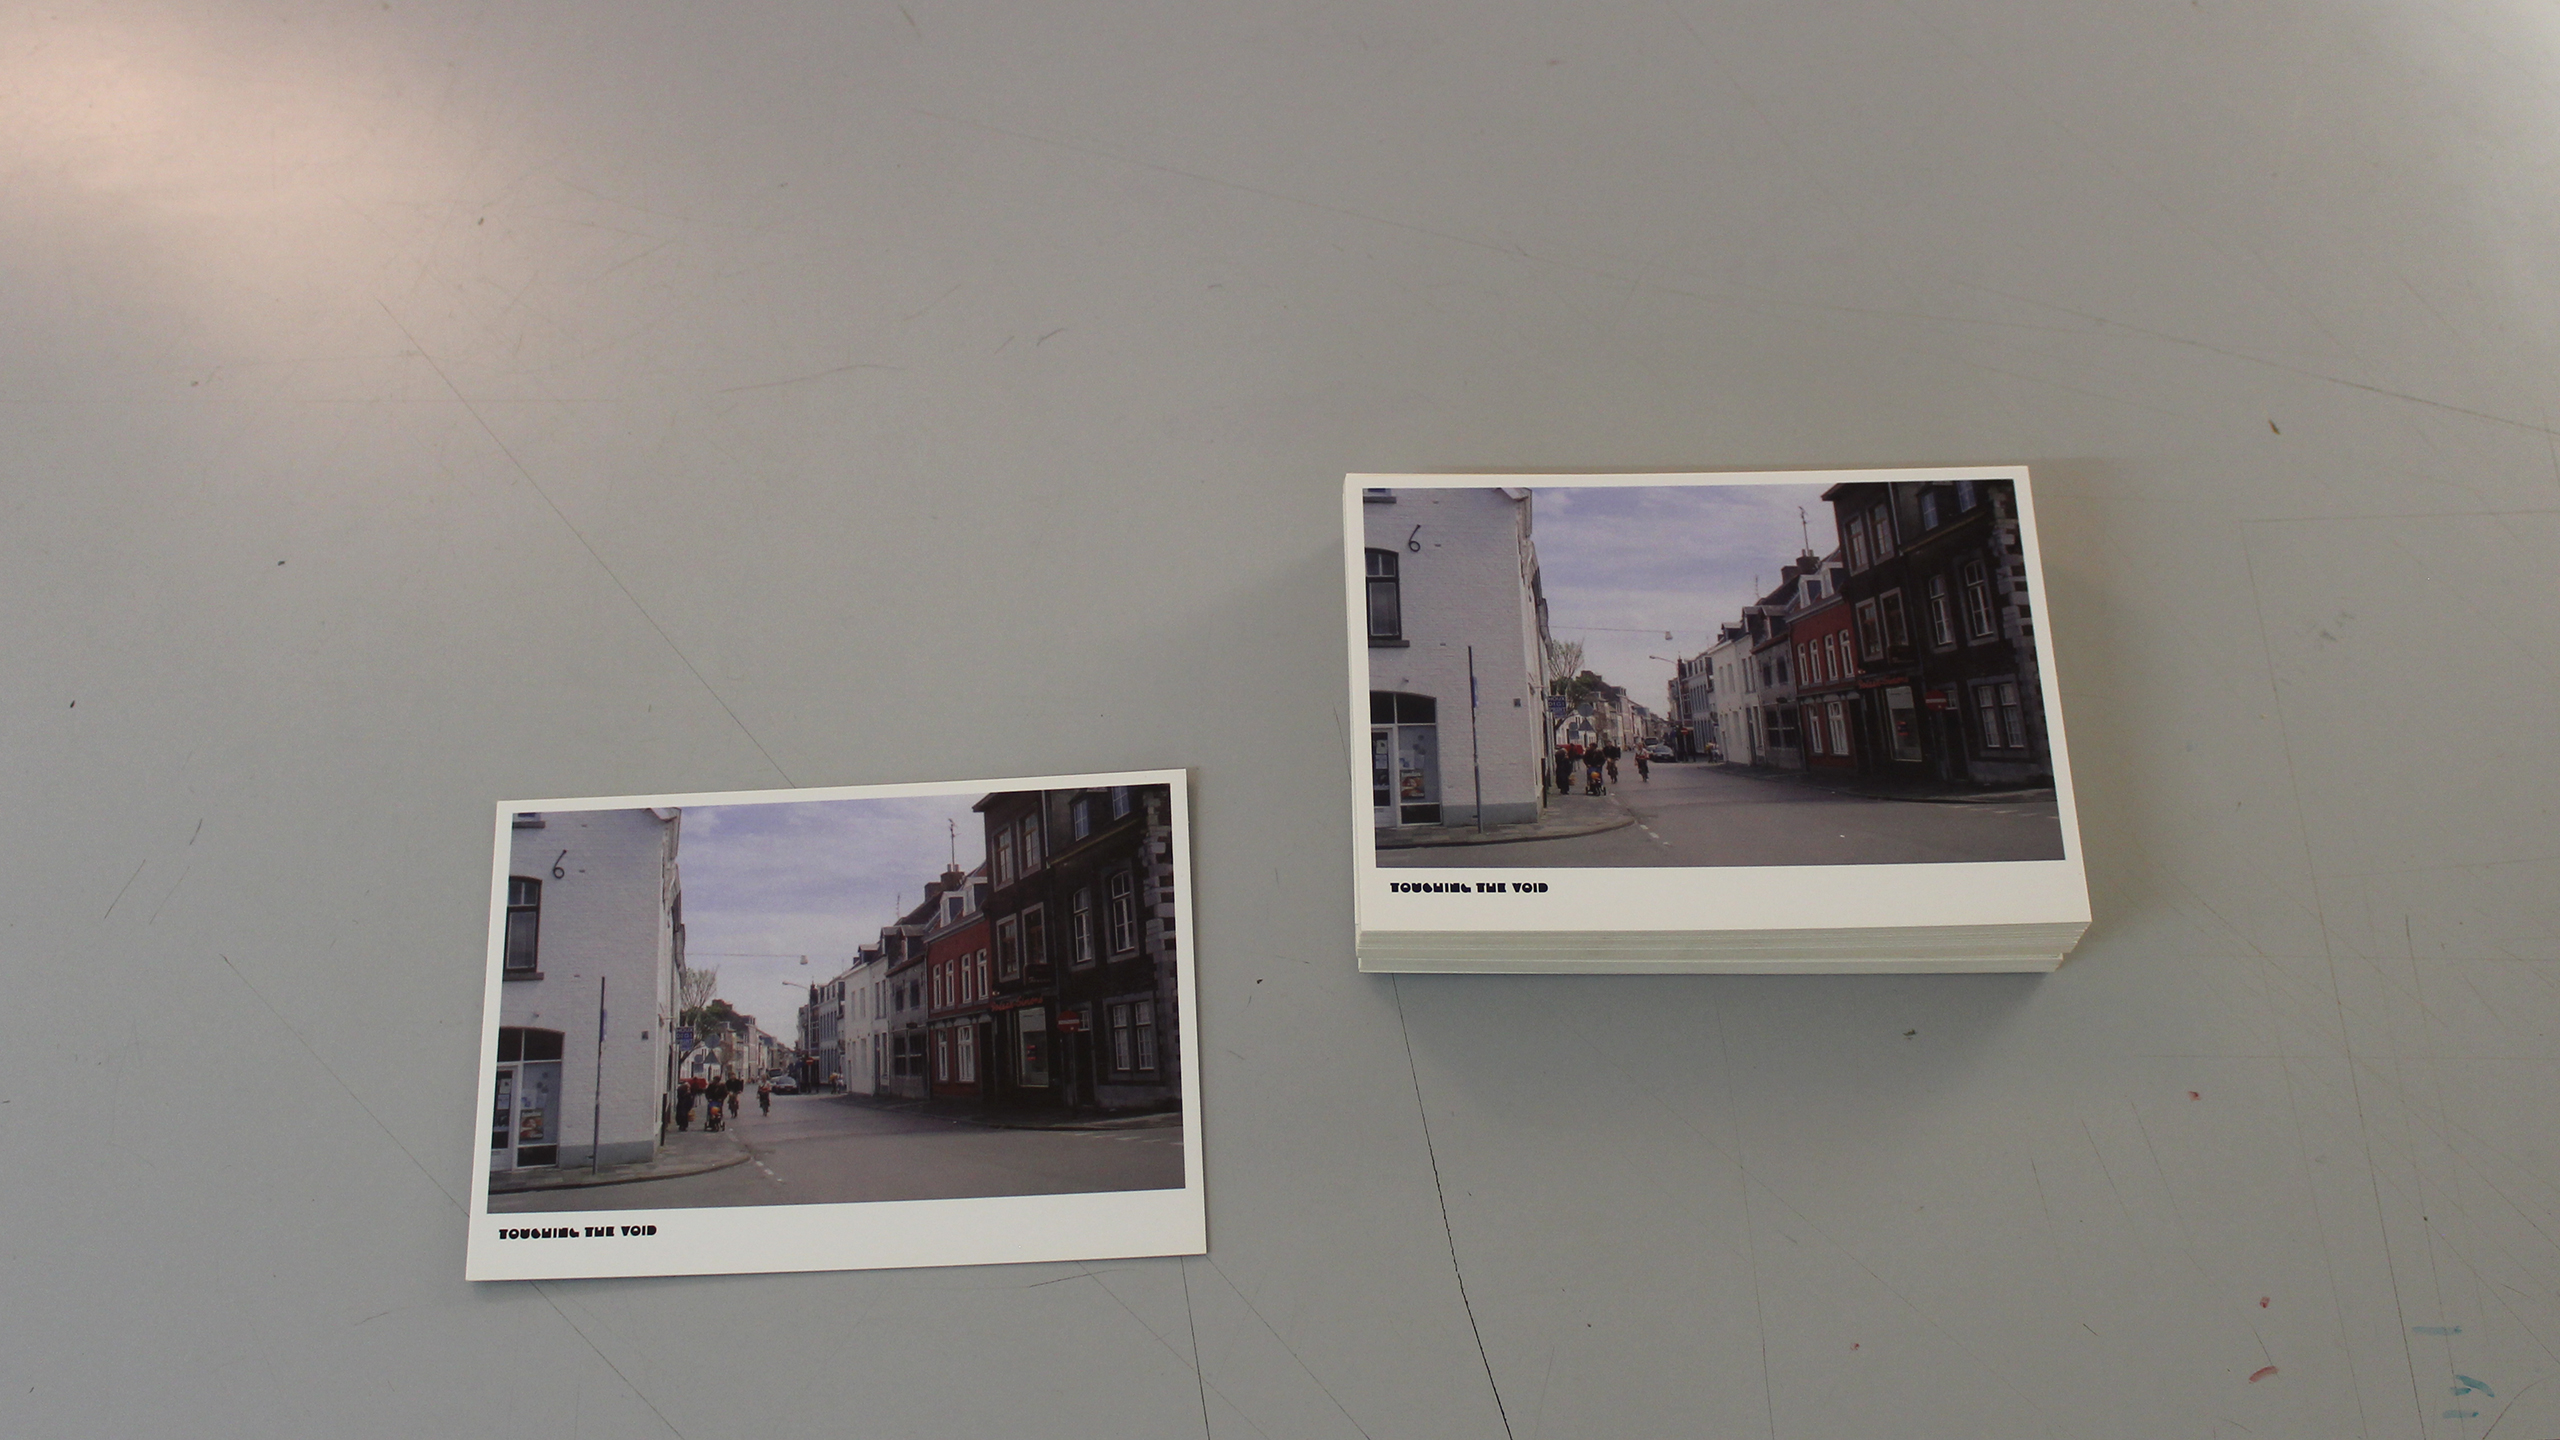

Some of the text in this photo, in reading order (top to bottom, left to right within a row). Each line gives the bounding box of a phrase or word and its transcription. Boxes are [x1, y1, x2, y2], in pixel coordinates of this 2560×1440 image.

[1408, 524, 1421, 553] 6
[552, 849, 567, 880] 6
[1390, 882, 1548, 893] TOUCHING THE VOID
[499, 1225, 657, 1239] TOUCHING THE VOID
